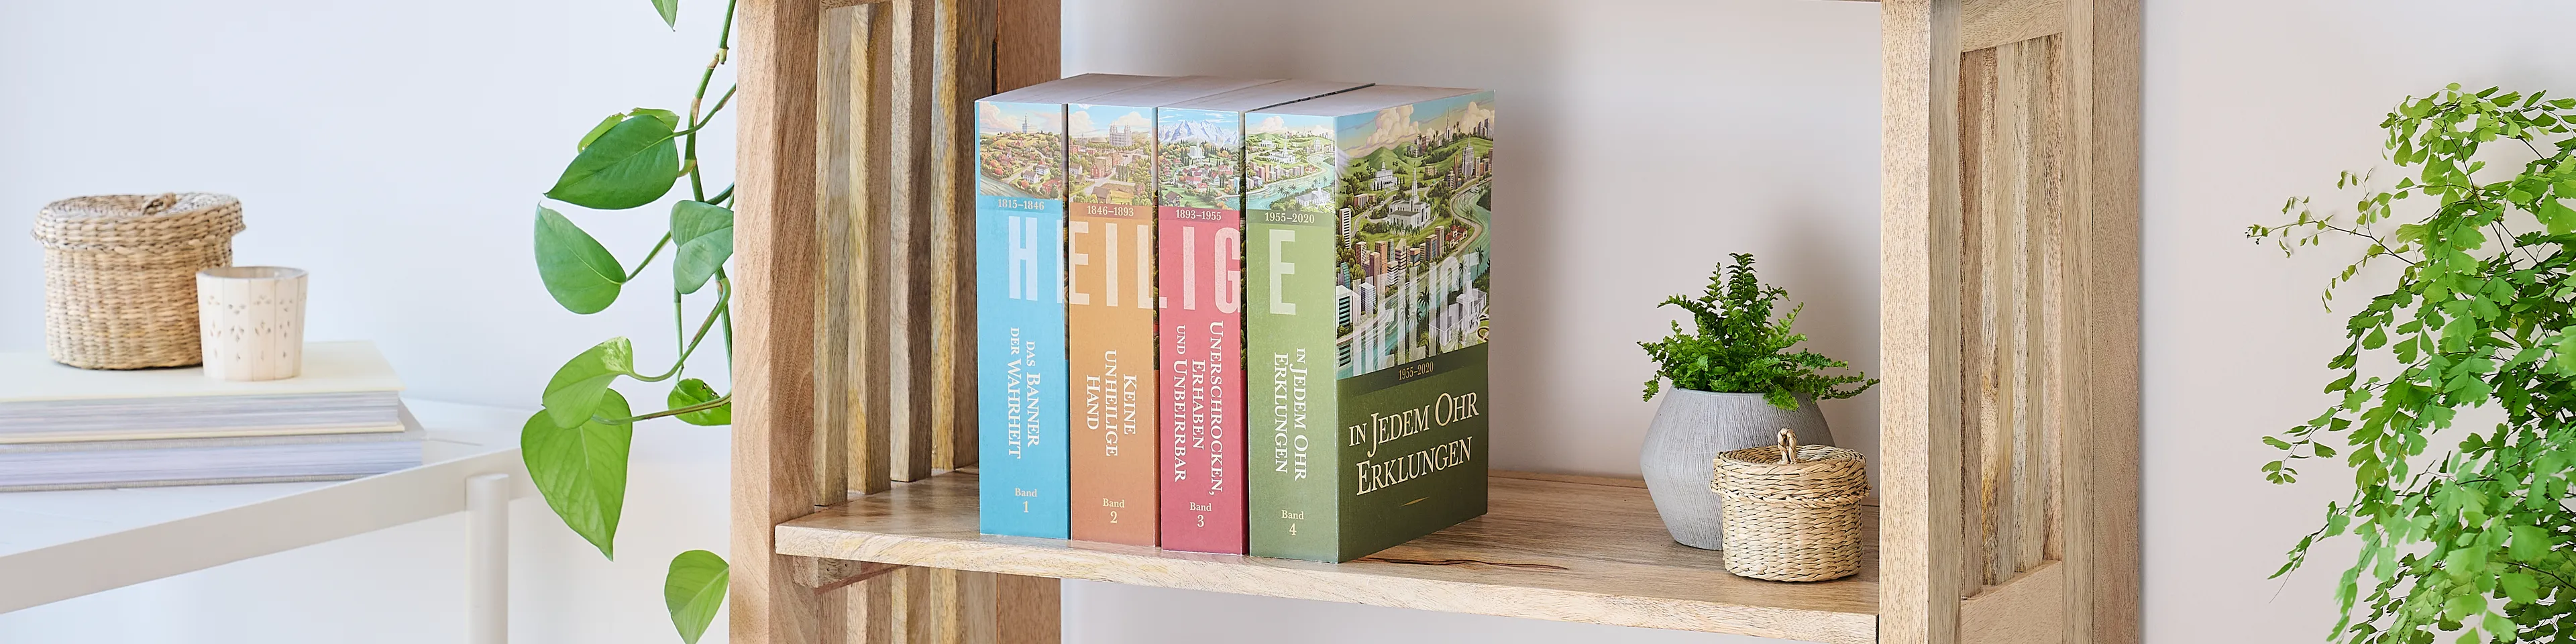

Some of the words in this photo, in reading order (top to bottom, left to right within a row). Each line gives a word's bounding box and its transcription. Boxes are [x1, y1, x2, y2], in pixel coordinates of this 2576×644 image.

[998, 199, 1044, 211] 1815–1846
[1087, 205, 1134, 217] 1846–1893
[1175, 209, 1222, 221] 1893–1955
[1265, 212, 1315, 224] 1955–2020
[1010, 327, 1020, 356] DER
[1176, 325, 1186, 355] UND
[1026, 341, 1035, 367] DAS
[1296, 347, 1306, 364] IN
[1398, 360, 1434, 381] 1955–2020
[1007, 358, 1022, 459] WAHRHEIT
[1026, 372, 1040, 447] BANNER
[1086, 374, 1100, 430] HAND
[1104, 350, 1118, 456] UNHEILIGE
[1123, 374, 1137, 435] KEINE
[1191, 359, 1206, 450] ERHABEN
[1208, 320, 1224, 496] UNERSCHROCKEN,
[1289, 363, 1308, 430] JEDEM
[1173, 359, 1187, 482] UNBEIRRBAR
[1274, 352, 1289, 474] ERKLUNGEN
[1348, 423, 1368, 447] IN
[1366, 405, 1430, 458] JEDEM
[1435, 392, 1480, 427] OHR
[1293, 435, 1309, 482] OHR
[1356, 436, 1472, 496] ERKLUNGEN
[1014, 488, 1038, 498] Band
[1022, 500, 1029, 513] 1
[1102, 498, 1125, 508] Band
[1110, 511, 1118, 524] 2
[1189, 502, 1212, 512] Band
[1281, 510, 1305, 520] Band
[1197, 515, 1205, 527] 3
[1289, 523, 1297, 535] 4
